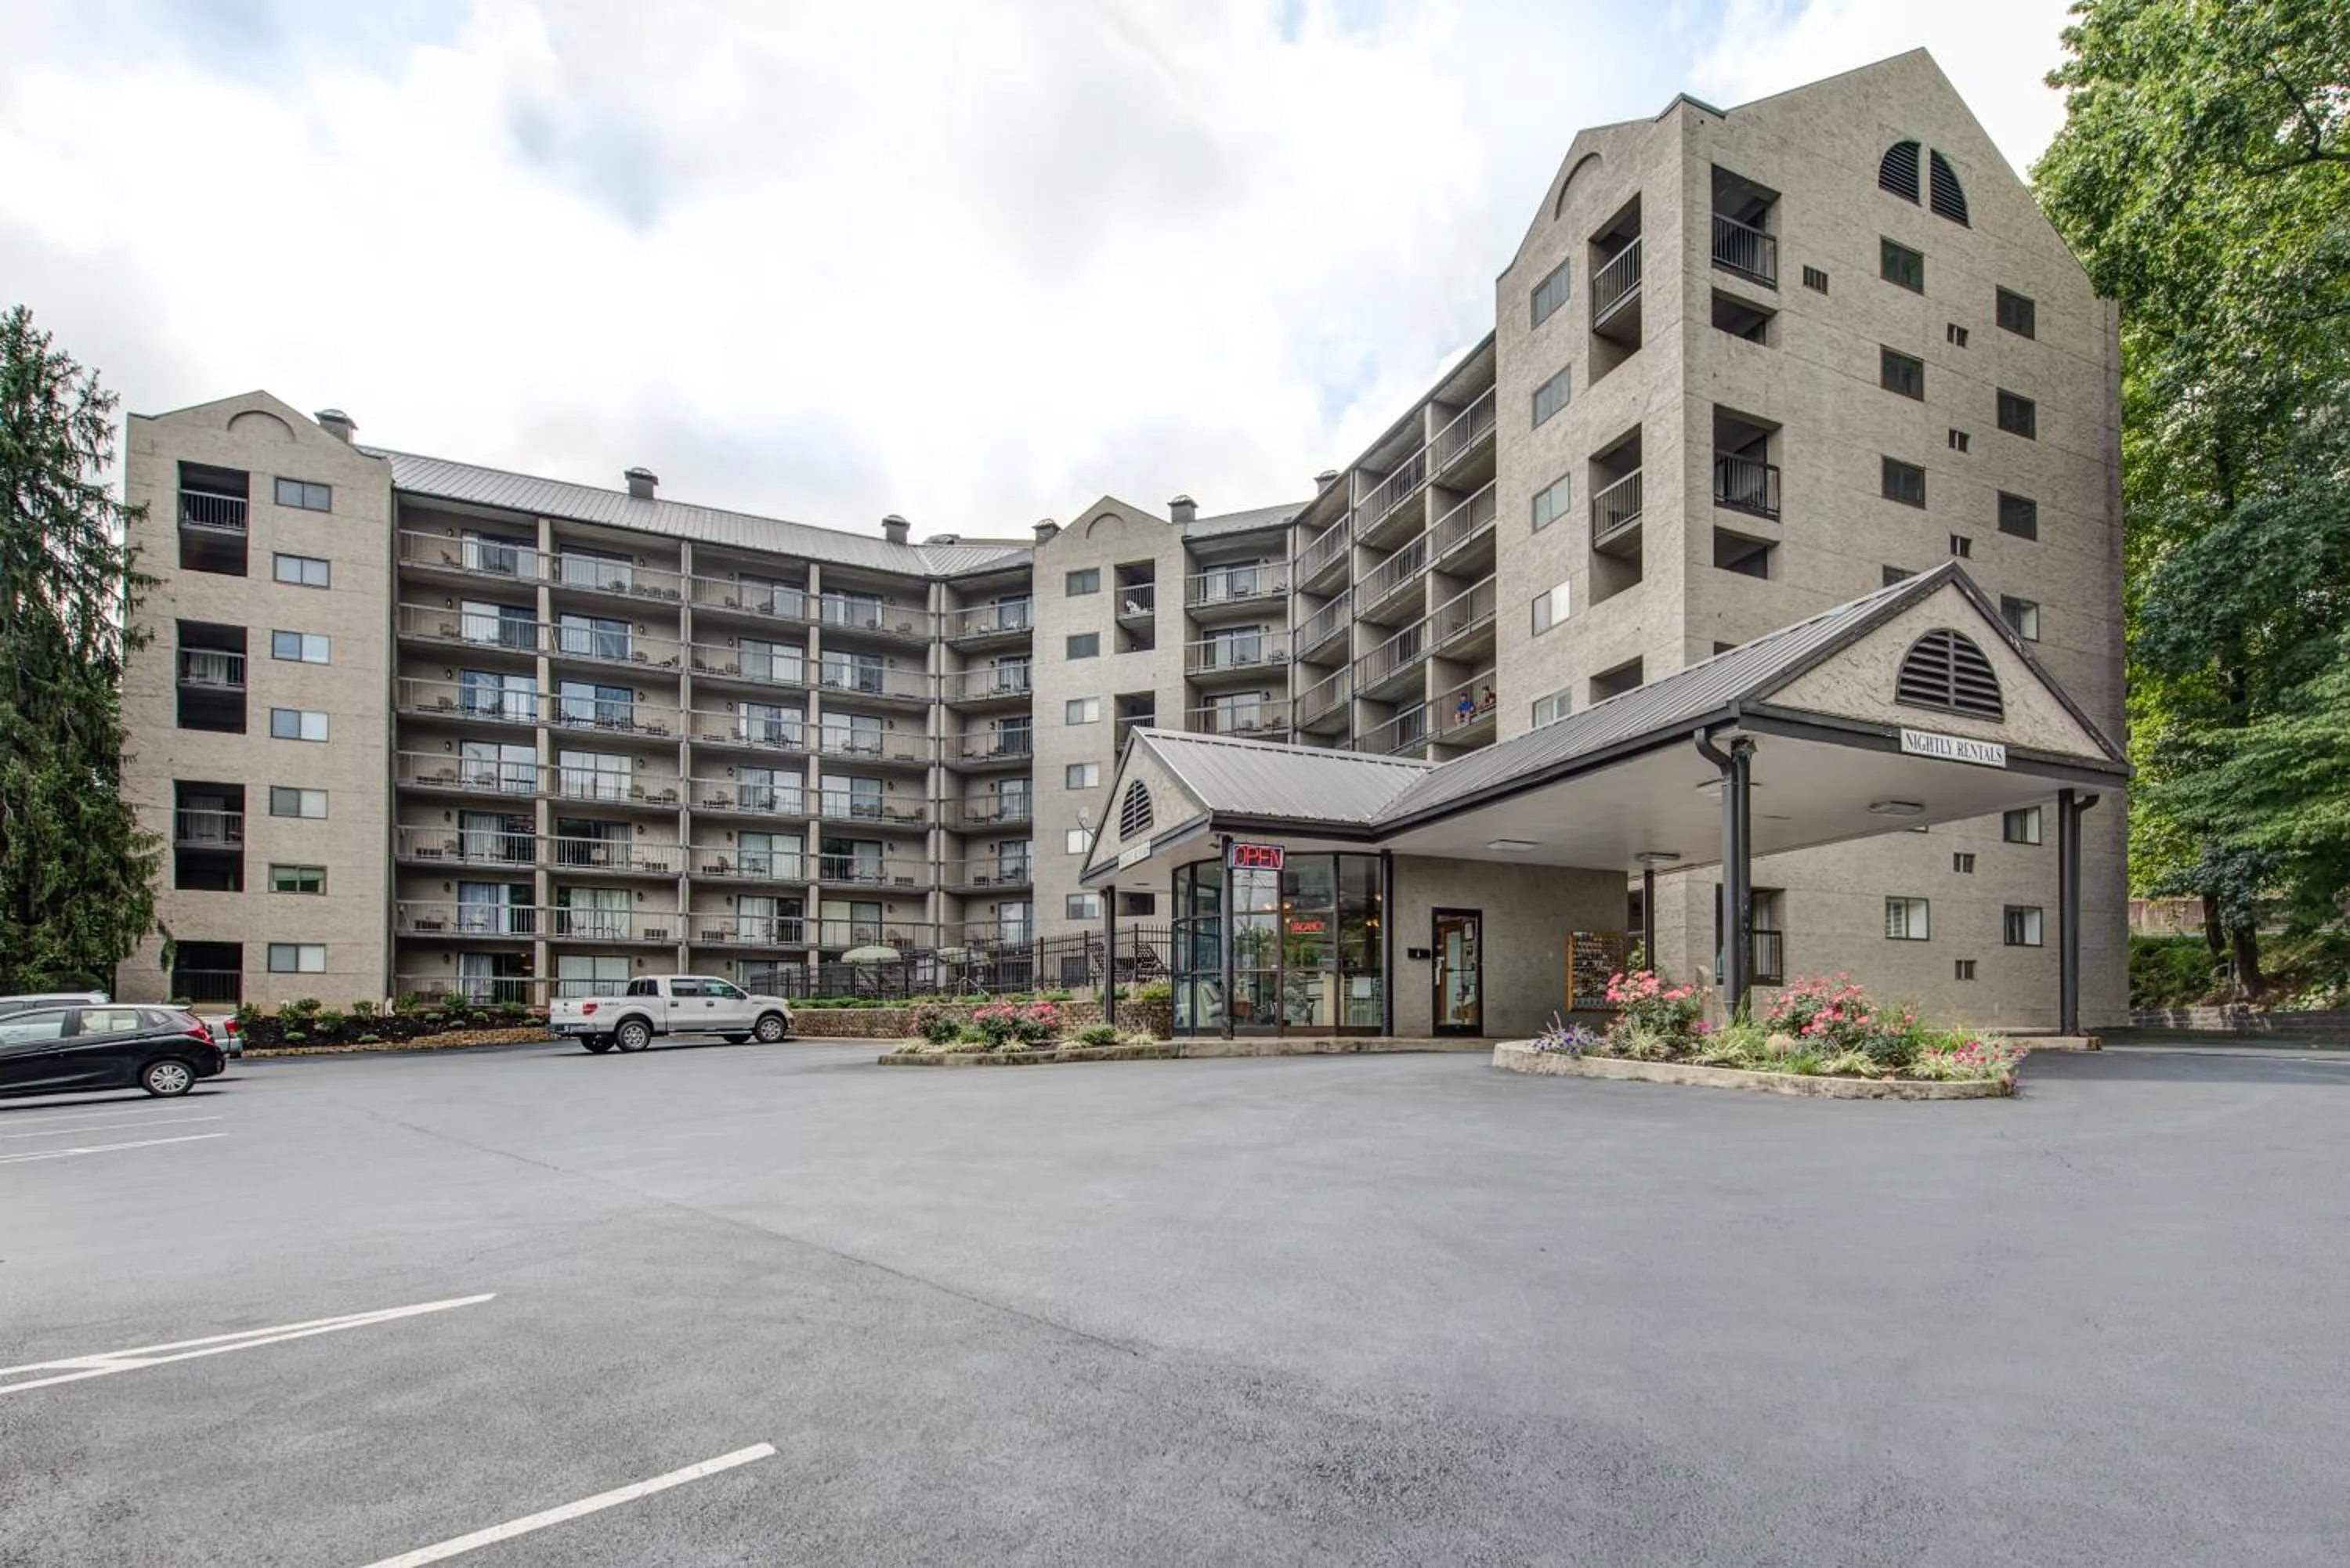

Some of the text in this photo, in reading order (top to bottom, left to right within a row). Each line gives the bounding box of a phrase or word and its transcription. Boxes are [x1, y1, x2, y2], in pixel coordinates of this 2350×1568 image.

[1906, 732, 2003, 763] NIGHTLY RENTALS
[1234, 845, 1281, 868] OPEN
